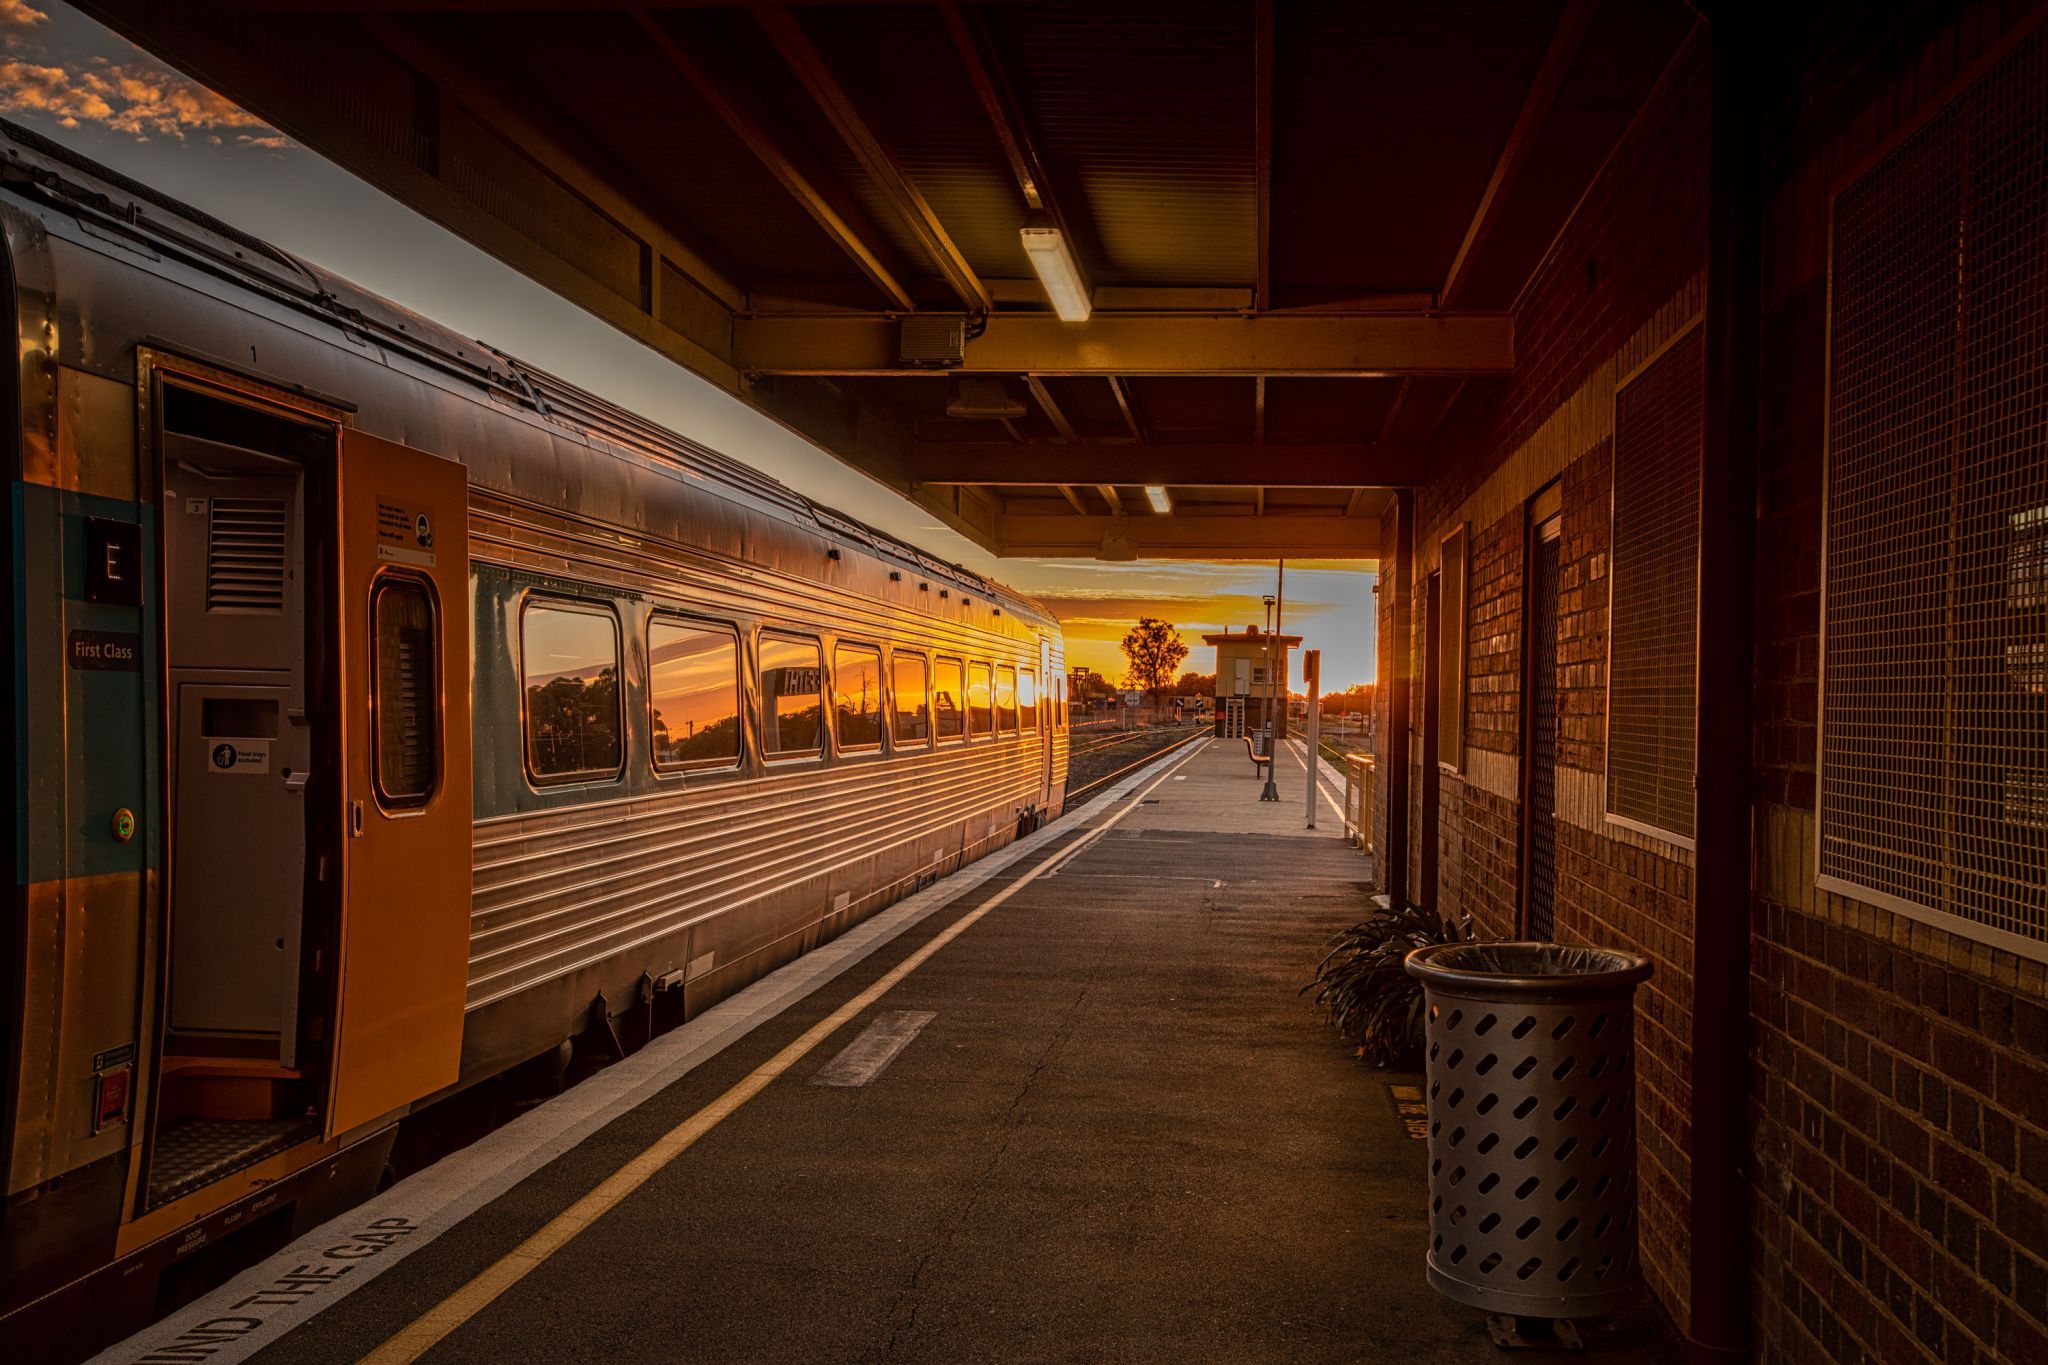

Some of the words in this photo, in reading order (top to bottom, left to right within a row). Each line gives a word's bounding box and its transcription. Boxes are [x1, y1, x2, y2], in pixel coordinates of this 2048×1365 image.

[250, 344, 257, 363] 1
[106, 541, 123, 580] E
[75, 641, 101, 658] First
[103, 642, 133, 660] Class
[176, 1233, 209, 1257] PRESSURE
[185, 1228, 203, 1243] DOOR
[229, 1264, 356, 1310] THE
[322, 1217, 419, 1261] GAP
